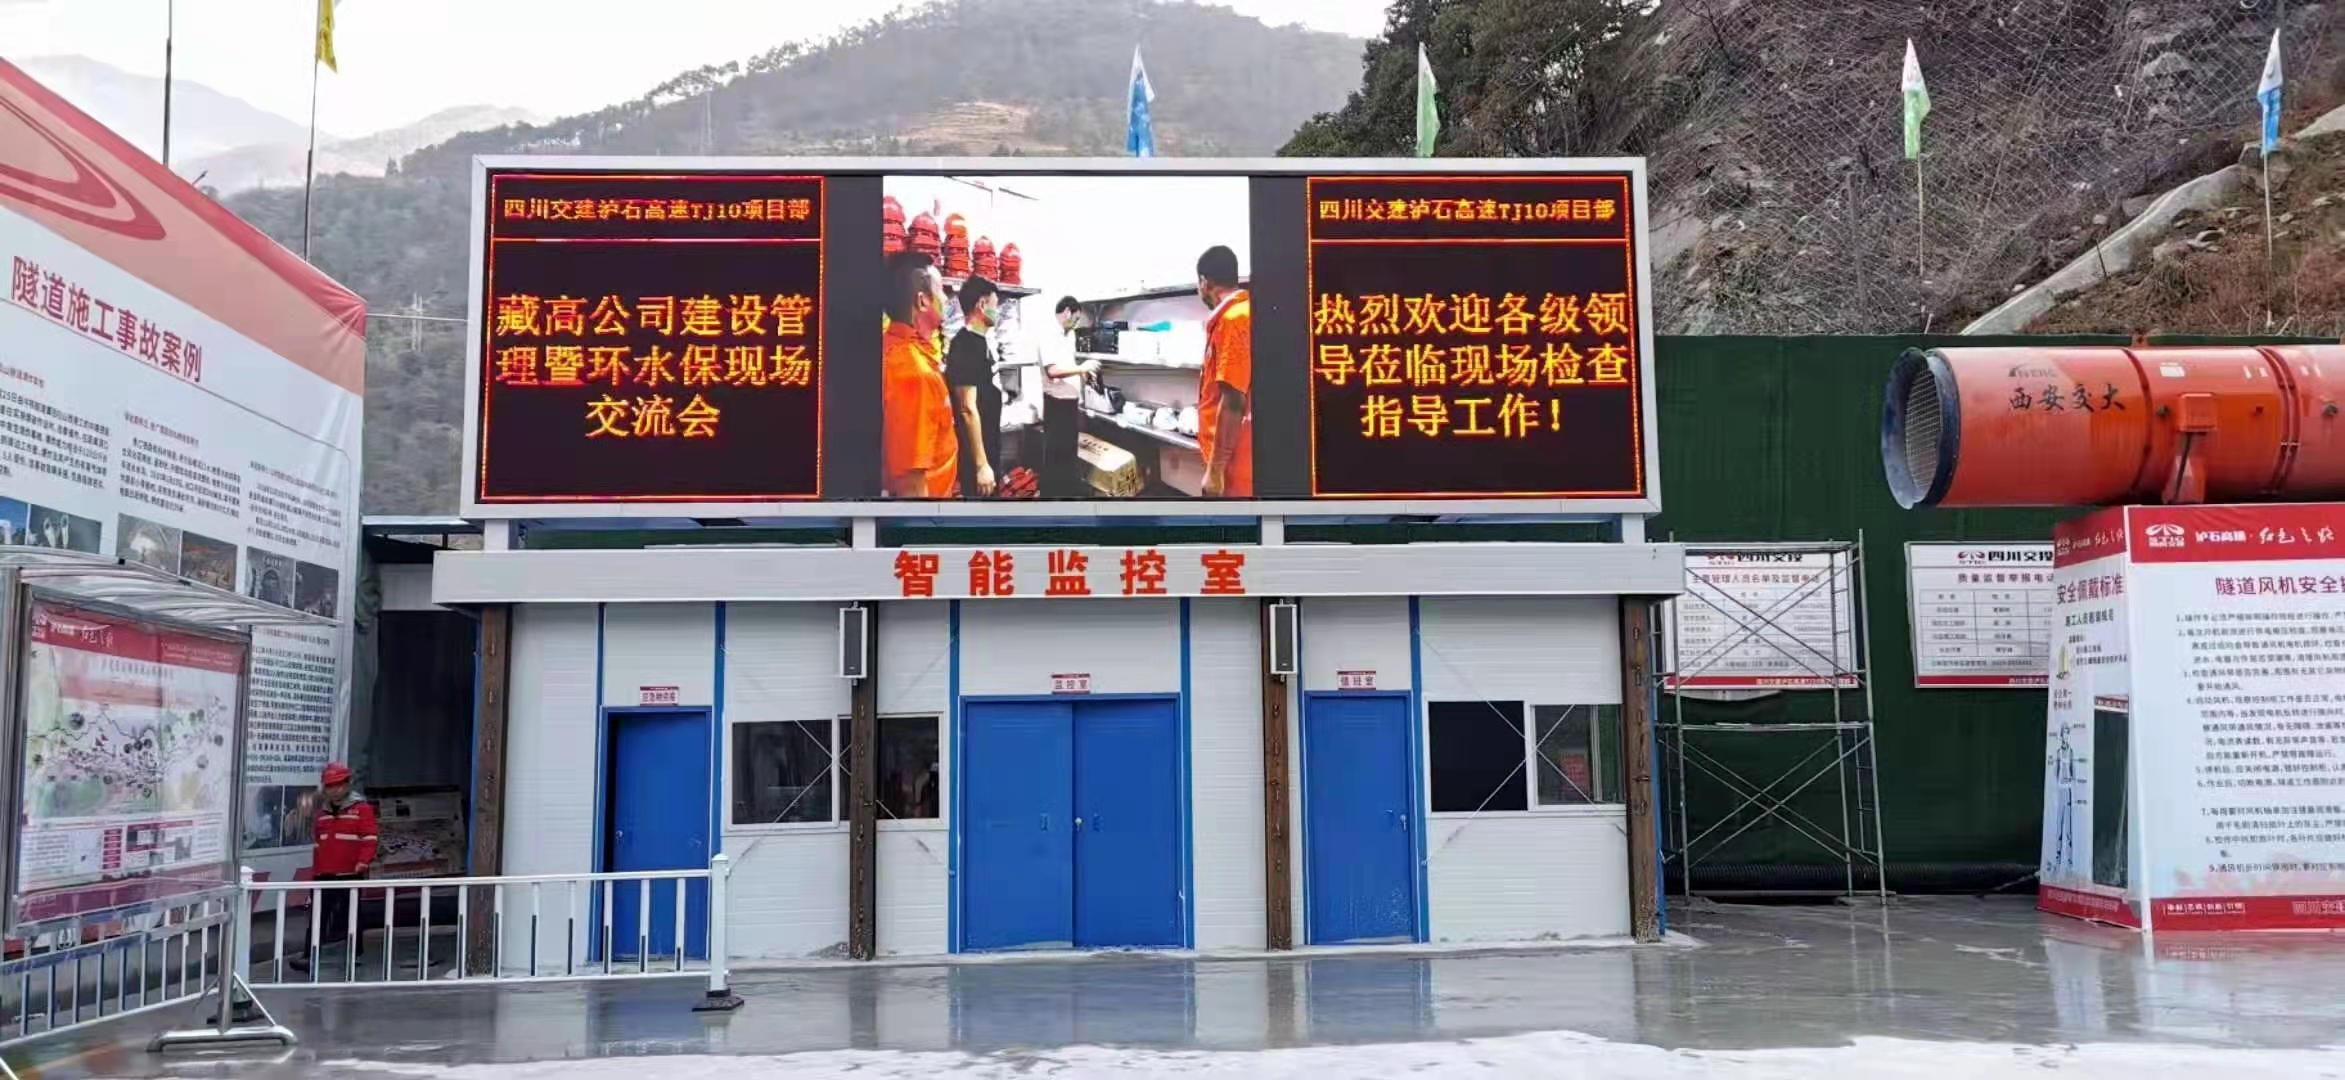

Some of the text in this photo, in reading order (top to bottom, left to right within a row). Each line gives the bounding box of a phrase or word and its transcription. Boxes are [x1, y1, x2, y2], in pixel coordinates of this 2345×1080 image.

[503, 198, 811, 221] 四川交建泸石高速TJ10项目部
[1319, 199, 1617, 222] 四川交建泸石高速TJ10项目部
[11, 255, 202, 383] 隧道施工事故案例
[496, 294, 813, 337] 藏高公司建设管
[1314, 293, 1629, 335] 热烈欢迎各级领
[496, 344, 812, 386] 理暨环水保现场
[1315, 343, 1629, 386] 导莅临现场检查
[585, 394, 721, 438] 交流会
[1360, 393, 1561, 438] 指导工作！
[2009, 383, 2125, 412] 西安交大
[894, 550, 1245, 597] 智能监控室
[1988, 551, 2054, 562] 四川交投
[2056, 574, 2125, 605] 安全佩戴标准
[2215, 576, 2345, 595] 隧道风机安全
